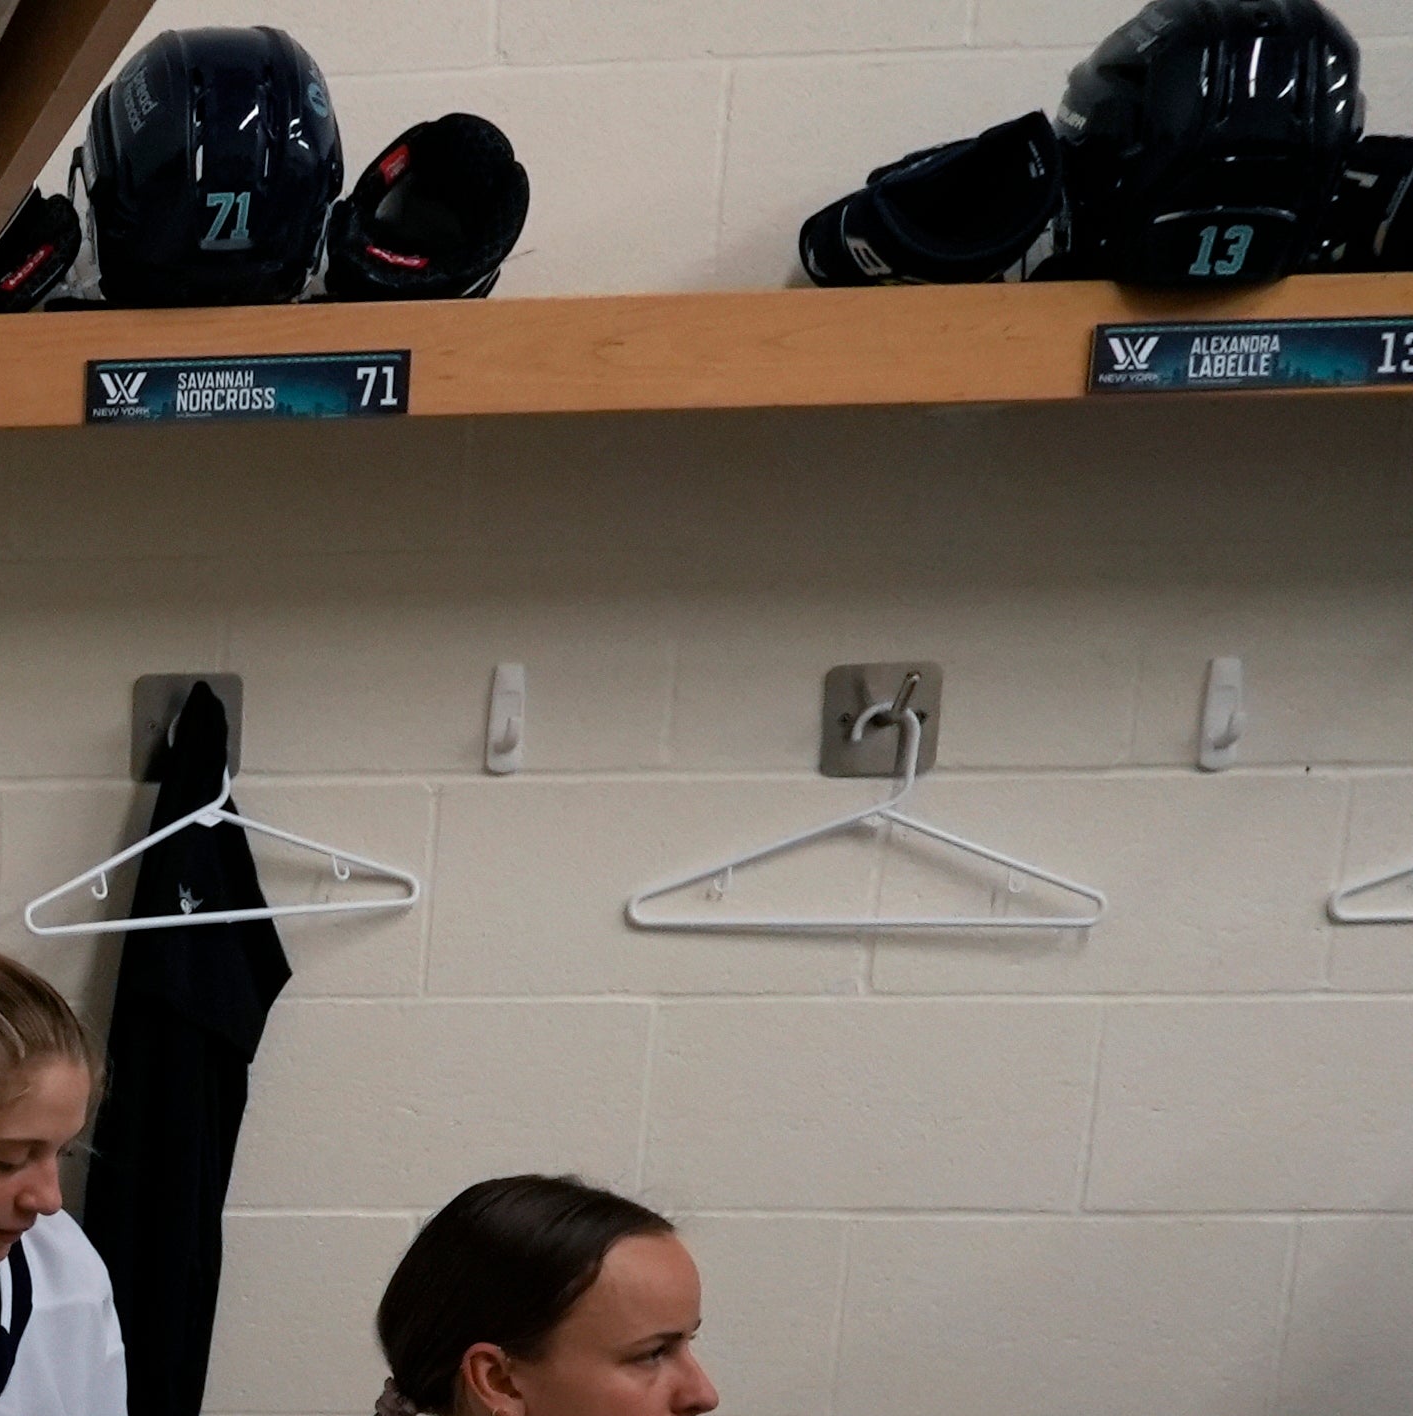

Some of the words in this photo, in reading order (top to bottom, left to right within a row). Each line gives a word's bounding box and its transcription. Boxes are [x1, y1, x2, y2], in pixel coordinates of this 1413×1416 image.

[205, 192, 251, 241] 71
[1189, 224, 1254, 275] 13
[1190, 334, 1281, 355] ALEXANDRA
[1098, 373, 1126, 383] NEW
[1188, 353, 1271, 378] LABELLE
[178, 370, 254, 390] SAVANNAH
[356, 366, 398, 407] 71
[93, 407, 119, 417] NEW
[121, 406, 150, 416] YORK
[176, 387, 276, 412] NORCROSS
